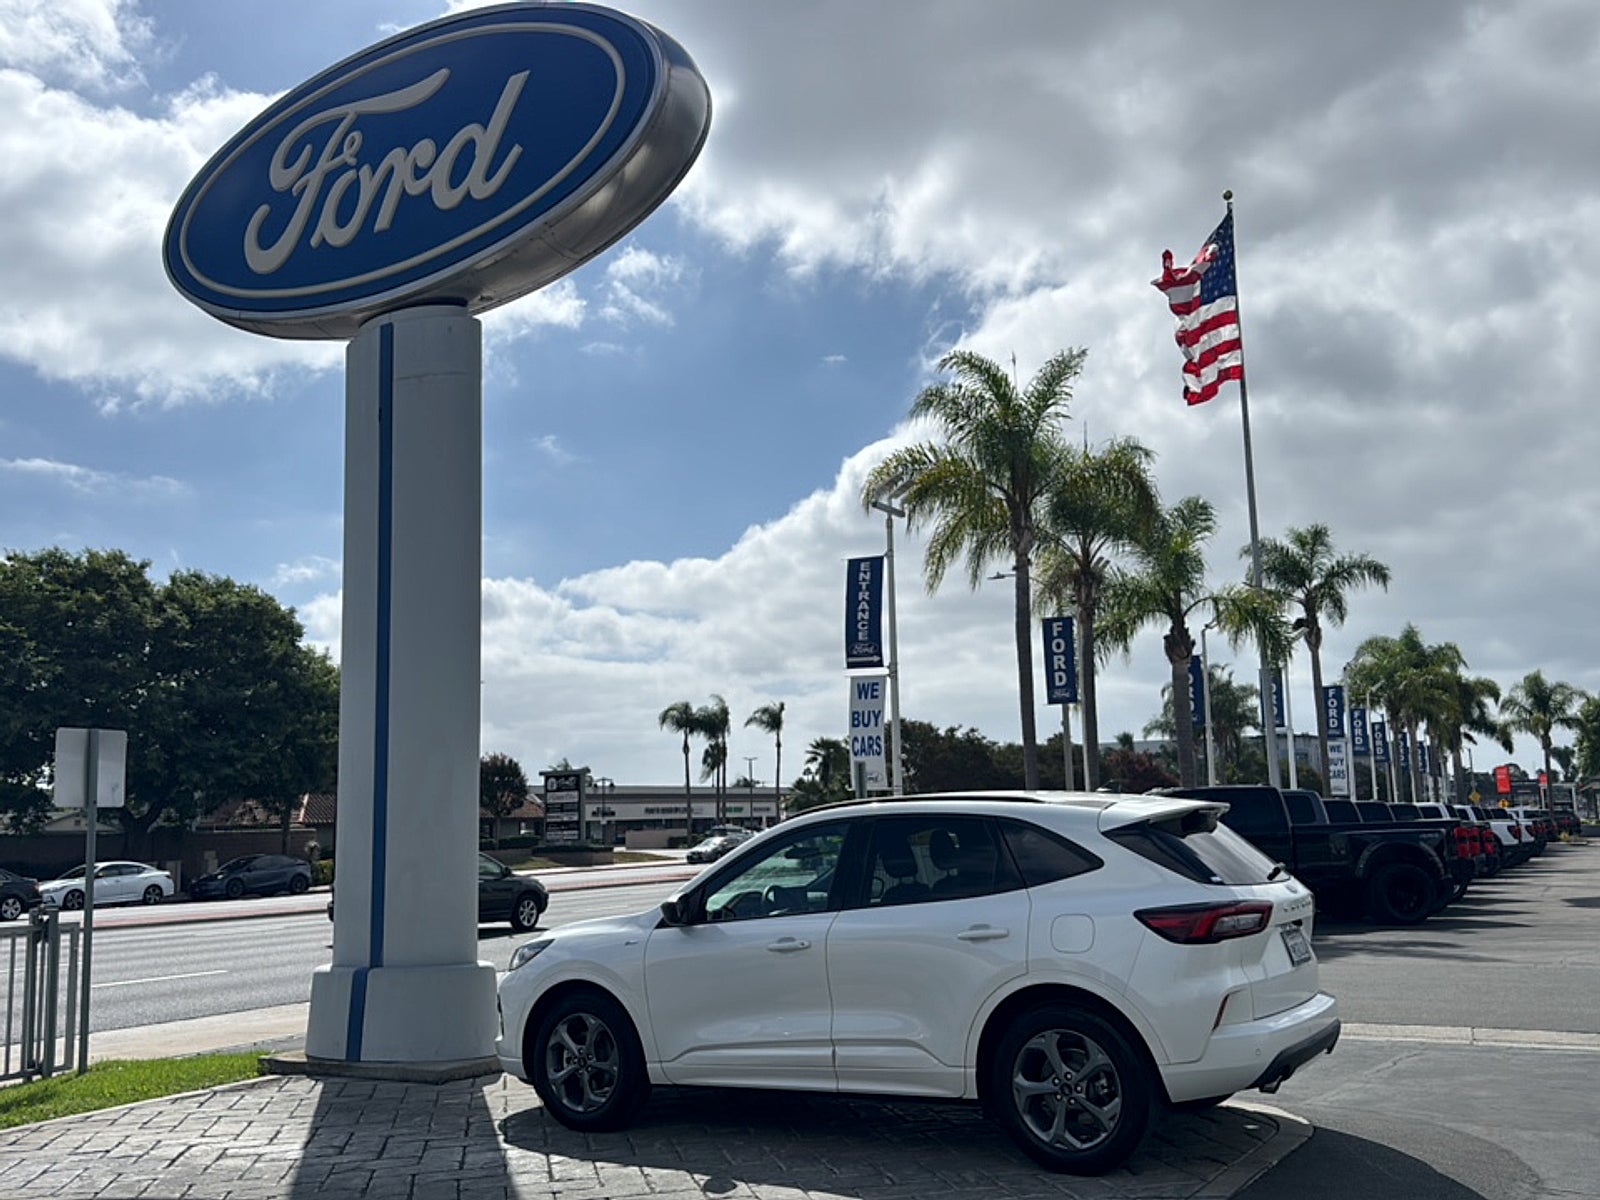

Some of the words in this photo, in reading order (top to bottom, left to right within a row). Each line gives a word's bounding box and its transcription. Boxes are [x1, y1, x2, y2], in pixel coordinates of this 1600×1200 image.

[243, 68, 531, 274] Ford
[857, 561, 871, 641] ENTRANCE
[1051, 622, 1067, 687] FORD
[857, 682, 879, 700] WE
[1328, 688, 1338, 728] FORD
[852, 710, 881, 728] BUY
[1353, 711, 1363, 745] FORD
[851, 736, 882, 757] CARS
